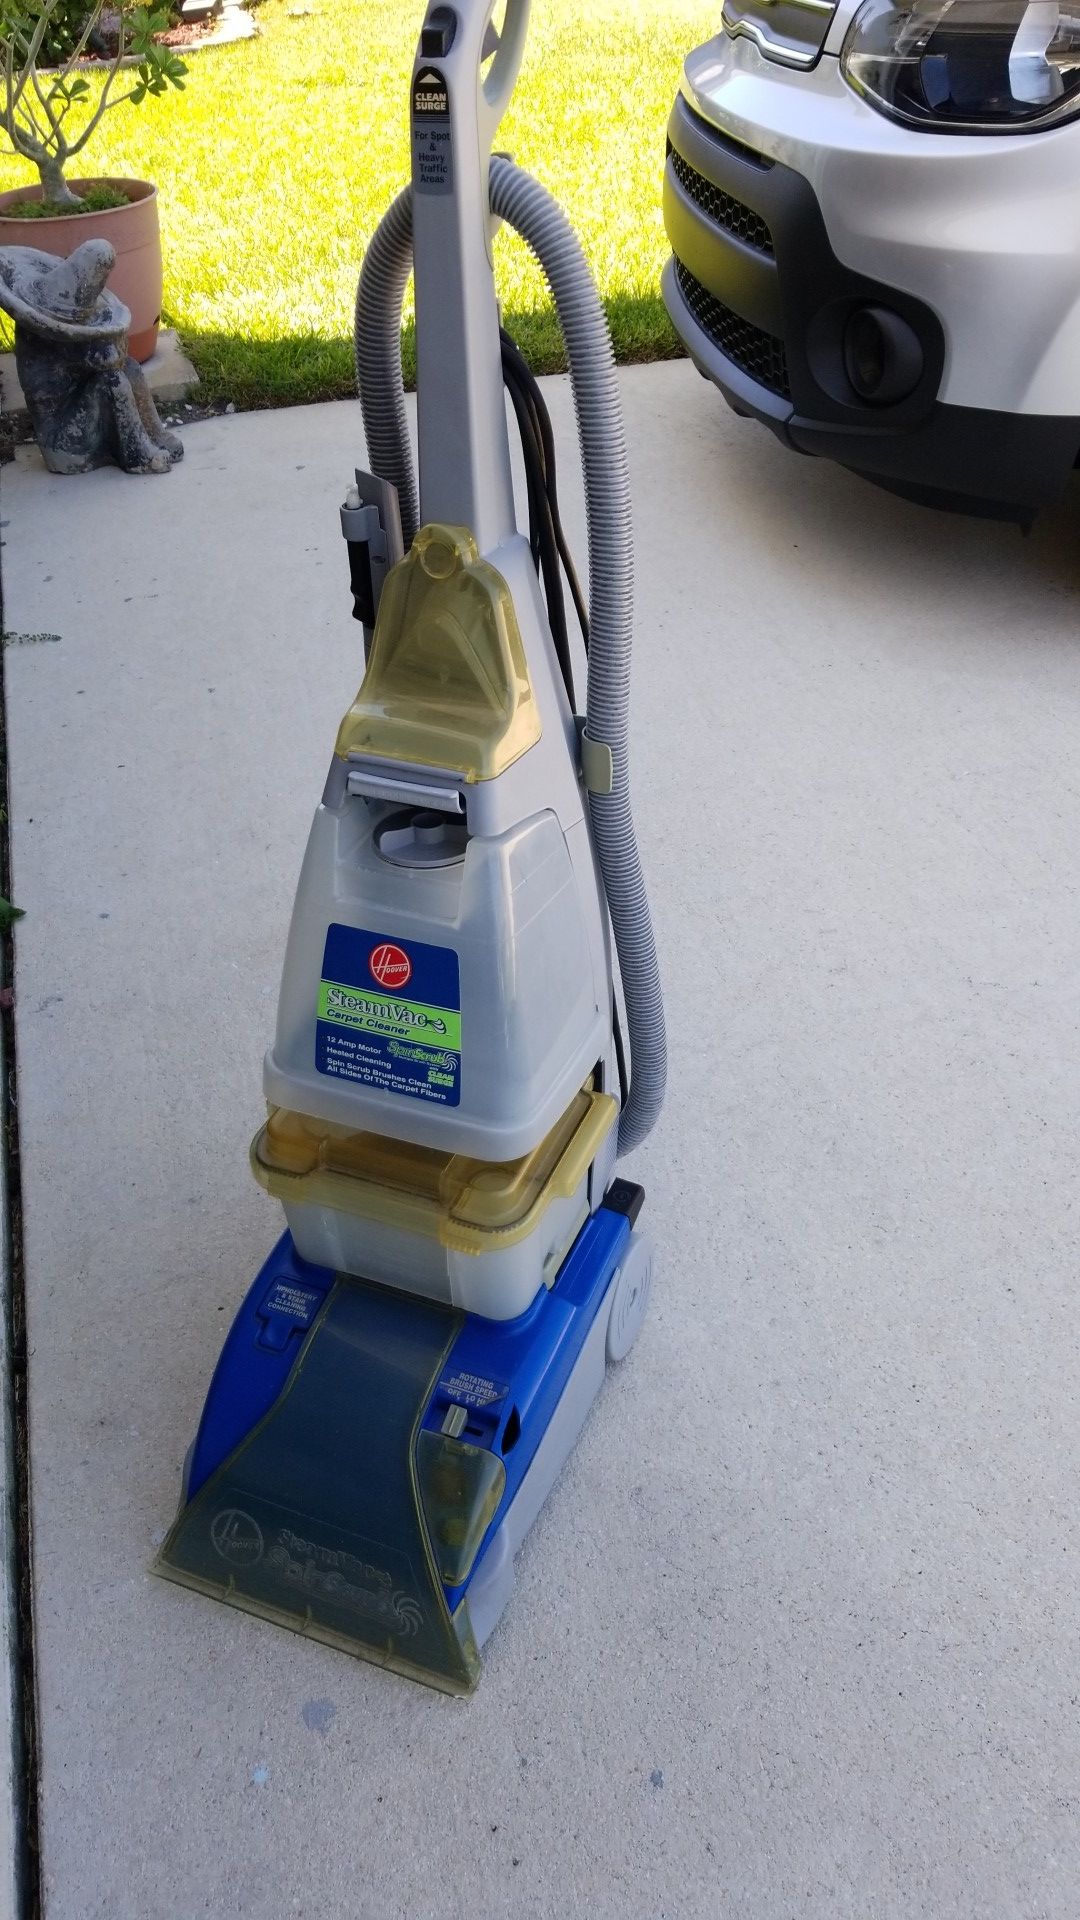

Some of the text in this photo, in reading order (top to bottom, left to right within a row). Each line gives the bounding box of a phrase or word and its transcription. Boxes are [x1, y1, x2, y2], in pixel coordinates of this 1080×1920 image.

[415, 93, 446, 101] CLEAN
[415, 102, 446, 110] SURGE
[415, 131, 450, 142] For Spot
[429, 143, 436, 151] &
[419, 152, 445, 163] Heavy
[420, 164, 447, 173] Traffic
[420, 174, 445, 183] Areas
[327, 988, 427, 1027] SteamVac
[326, 1008, 410, 1036] Carpet Cleaner
[327, 1035, 381, 1054] 12 Amp Motor
[327, 1046, 354, 1059] Heated
[356, 1054, 392, 1070] Cleaning
[327, 1057, 432, 1089] Spin Scrub Brushes Clean
[327, 1064, 447, 1100] All Sides Of The Carpet Fibers
[267, 1301, 309, 1319] CONNECTION
[275, 1297, 307, 1311] CLEANING
[449, 1378, 498, 1398] BRUSH SPEED
[459, 1372, 494, 1389] ROTATING
[448, 1388, 462, 1397] OFF
[466, 1394, 476, 1402] LO
